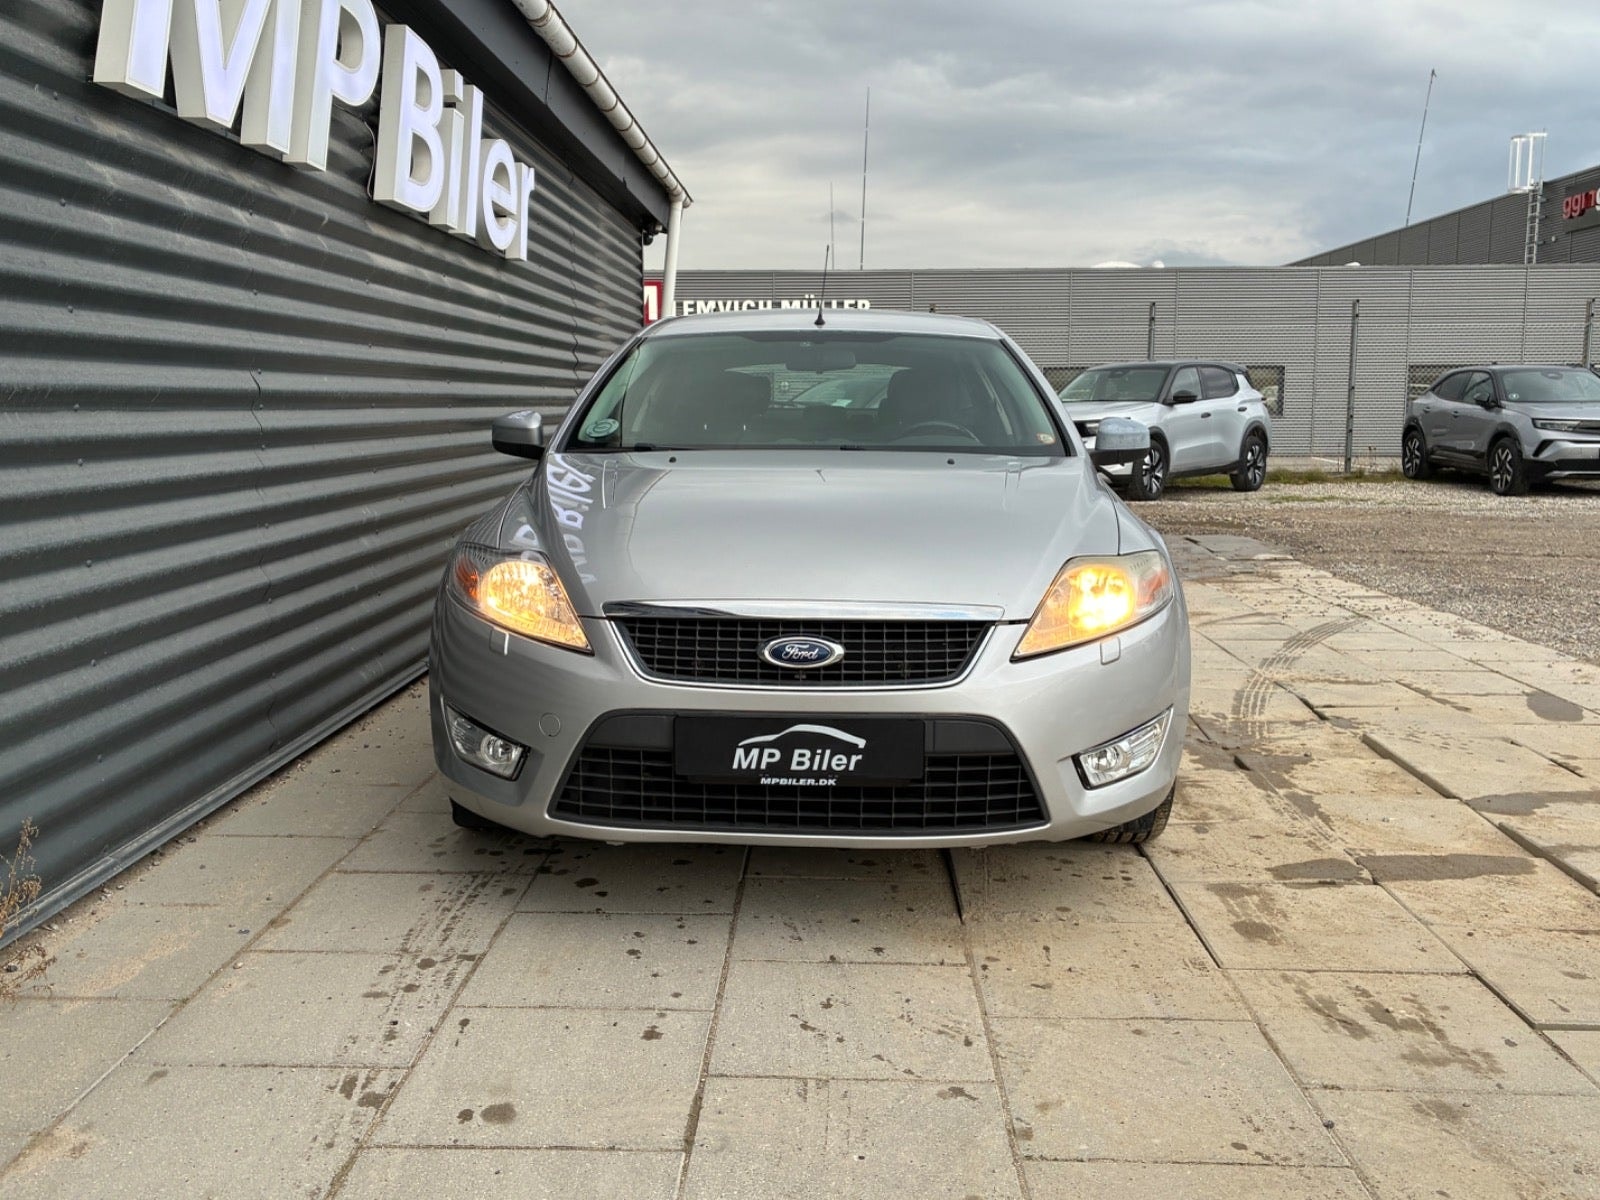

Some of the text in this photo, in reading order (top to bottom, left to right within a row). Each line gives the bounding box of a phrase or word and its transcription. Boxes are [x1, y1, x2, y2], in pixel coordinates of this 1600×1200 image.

[94, 0, 534, 261] MP Biler
[782, 643, 819, 660] Ford
[732, 747, 863, 772] MP Biler
[760, 777, 837, 786] MPBILER.DK
